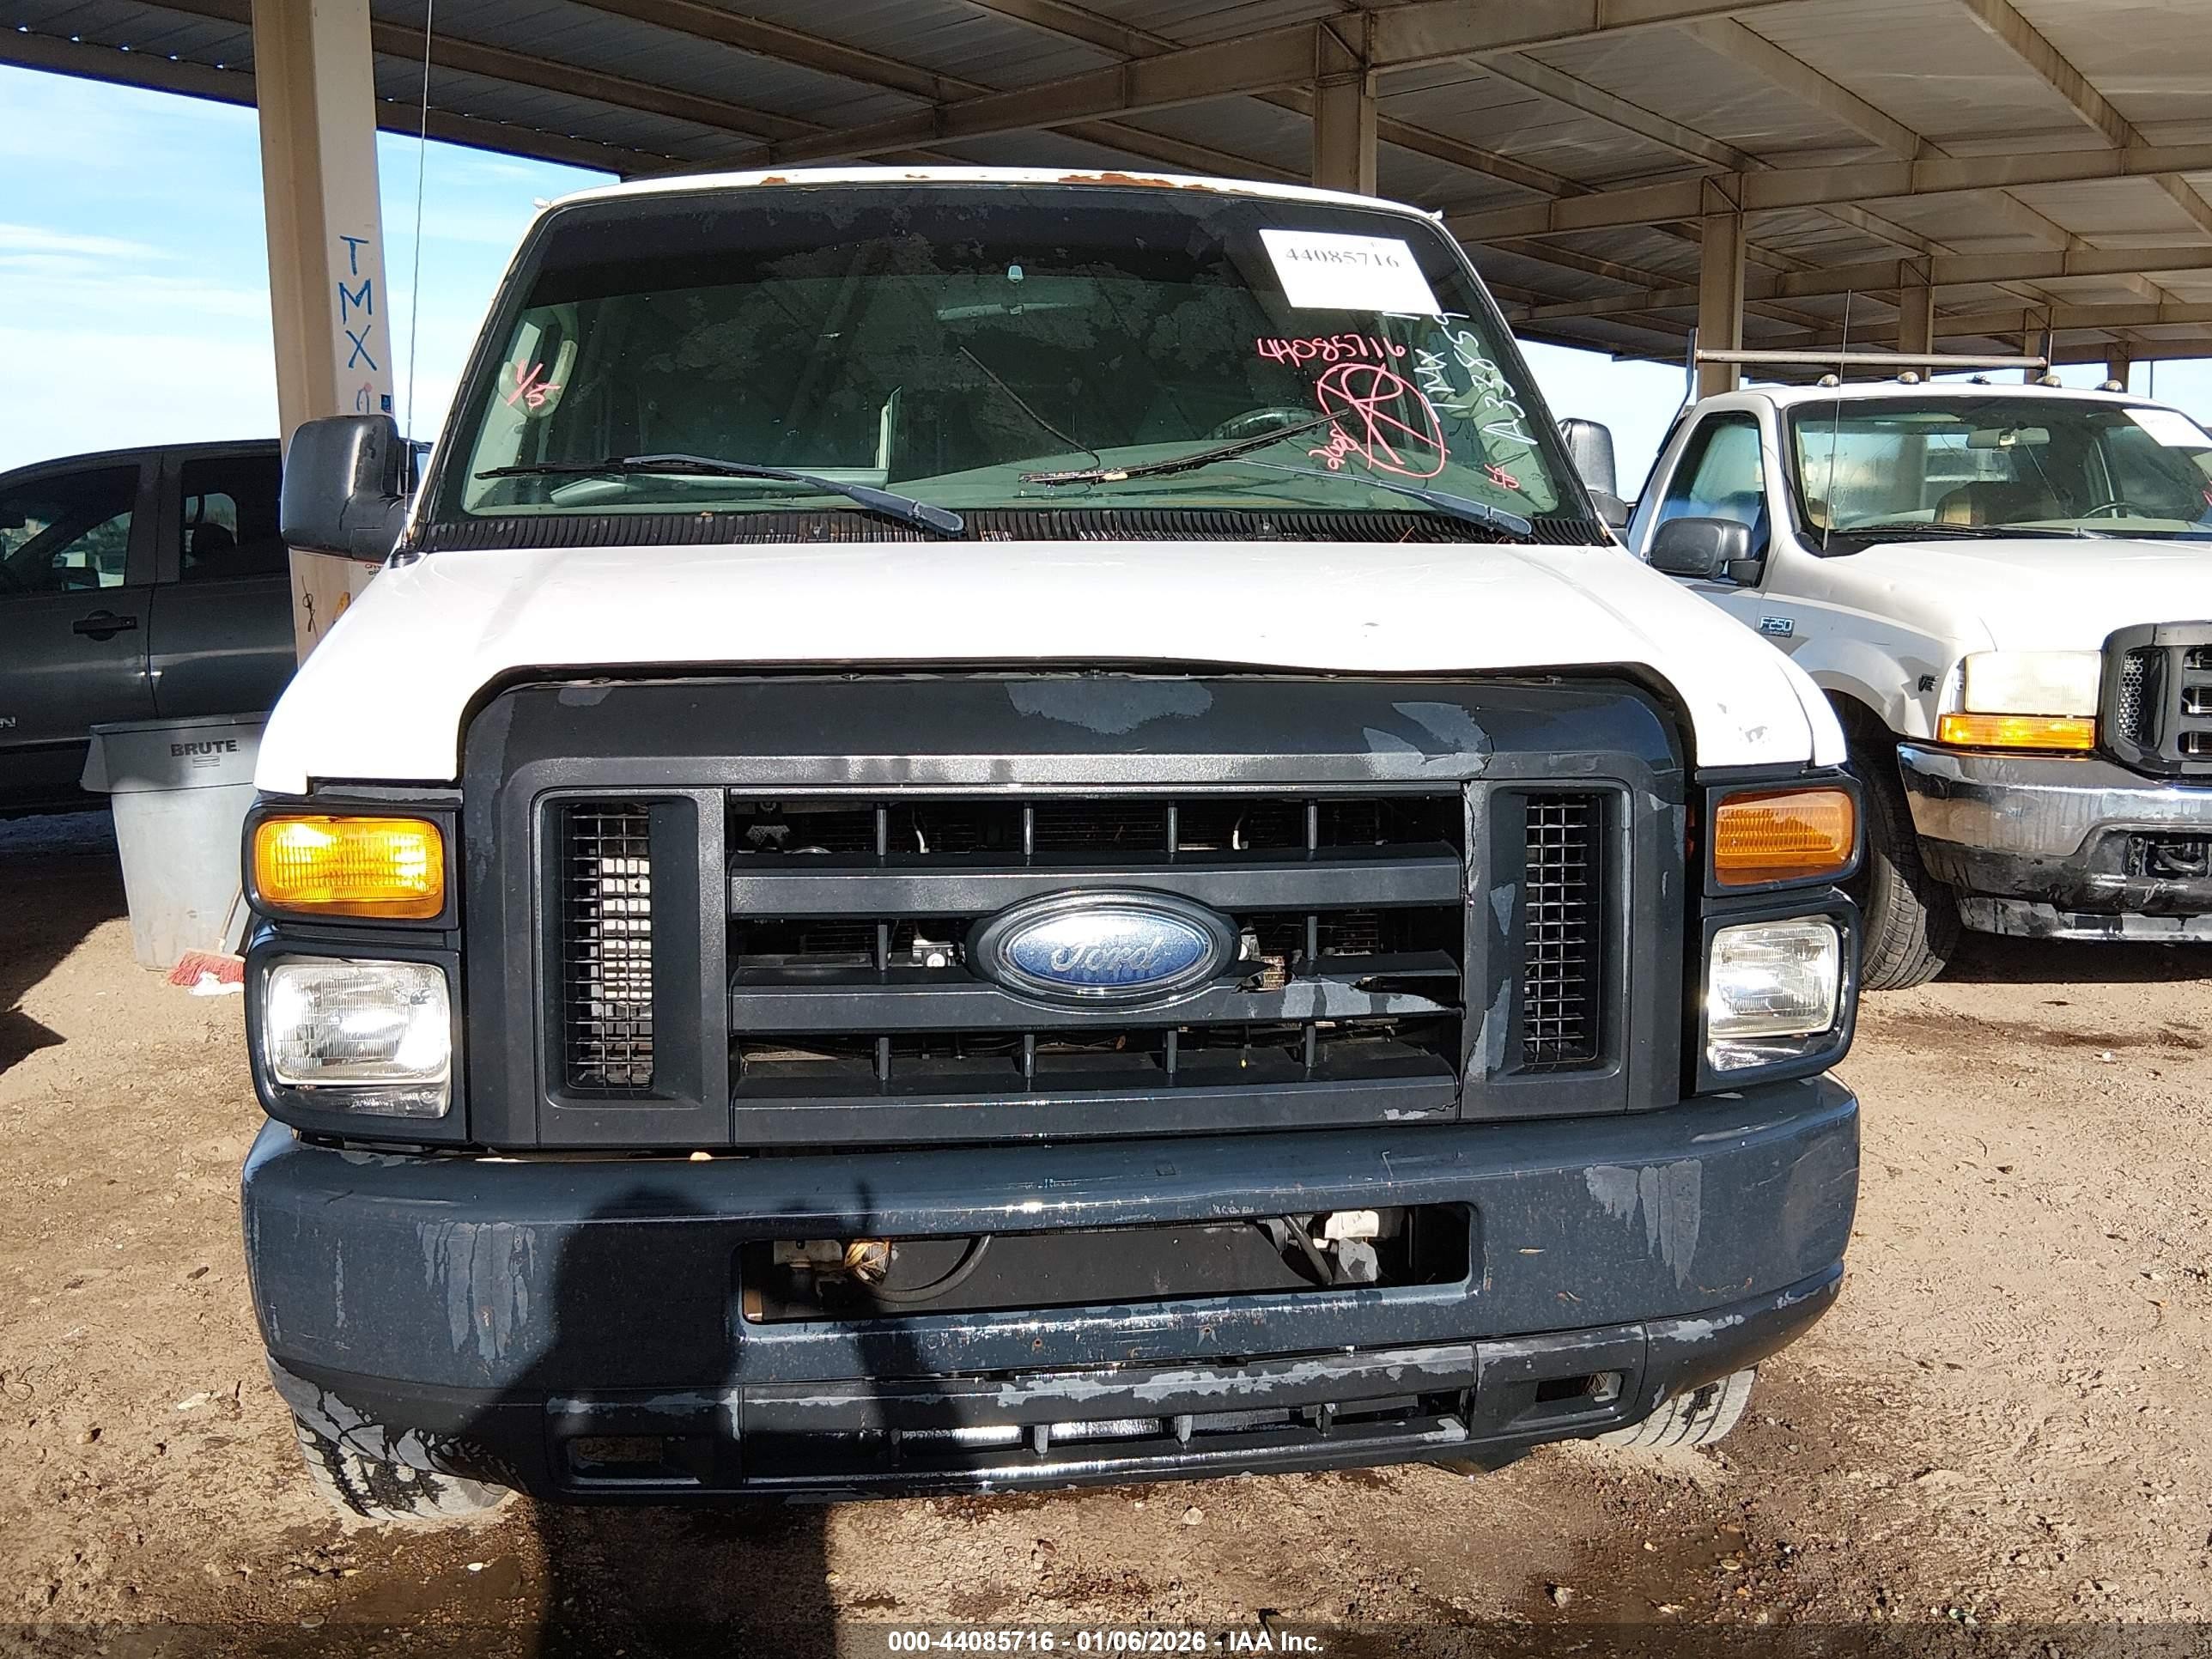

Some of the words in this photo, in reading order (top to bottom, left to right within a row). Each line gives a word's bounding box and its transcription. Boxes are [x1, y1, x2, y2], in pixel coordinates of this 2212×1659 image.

[1286, 247, 1400, 268] 44085716
[339, 234, 377, 371] TMX
[1257, 334, 1407, 368] 44085716
[1759, 617, 1794, 632] F250
[171, 739, 238, 757] BRUTE
[1050, 936, 1164, 972] Ford
